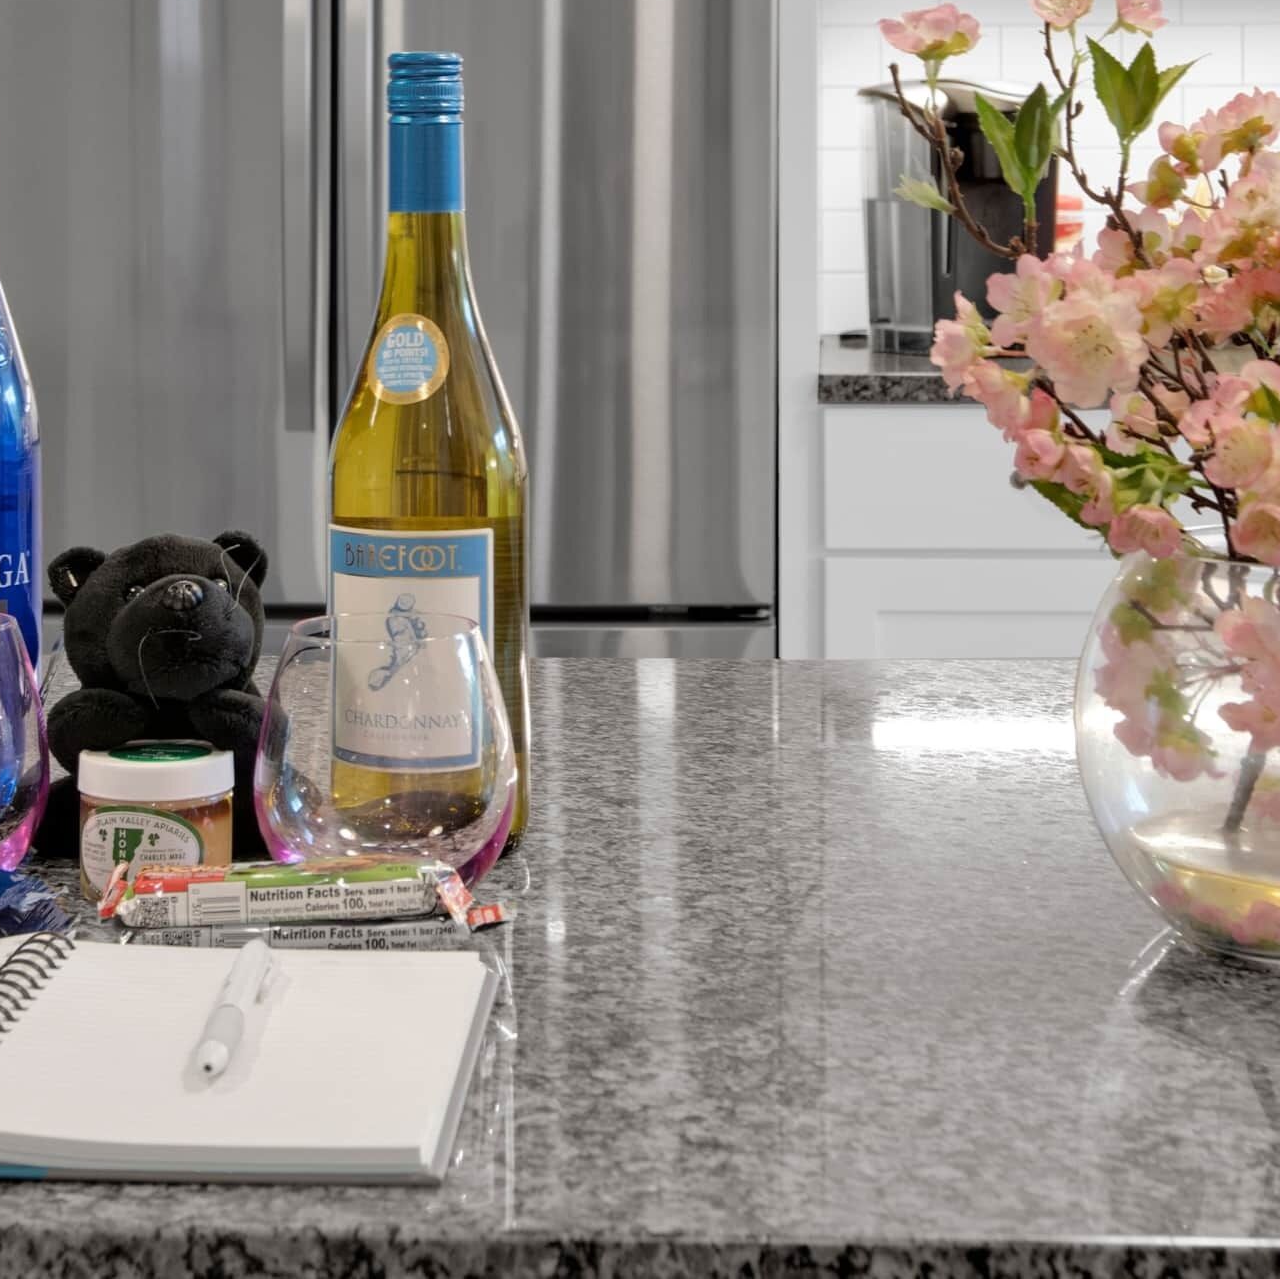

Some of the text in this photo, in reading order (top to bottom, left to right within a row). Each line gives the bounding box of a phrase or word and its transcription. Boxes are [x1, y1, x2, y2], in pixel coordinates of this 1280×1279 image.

[386, 332, 425, 348] GOLD
[345, 542, 460, 571] BAREFOOT
[250, 888, 303, 902] Nutrition
[307, 886, 341, 899] Facts
[305, 902, 340, 912] Calories
[342, 897, 368, 910] 100,
[273, 927, 326, 940] Nutrition
[330, 927, 364, 939] Facts
[365, 937, 390, 951] 100,
